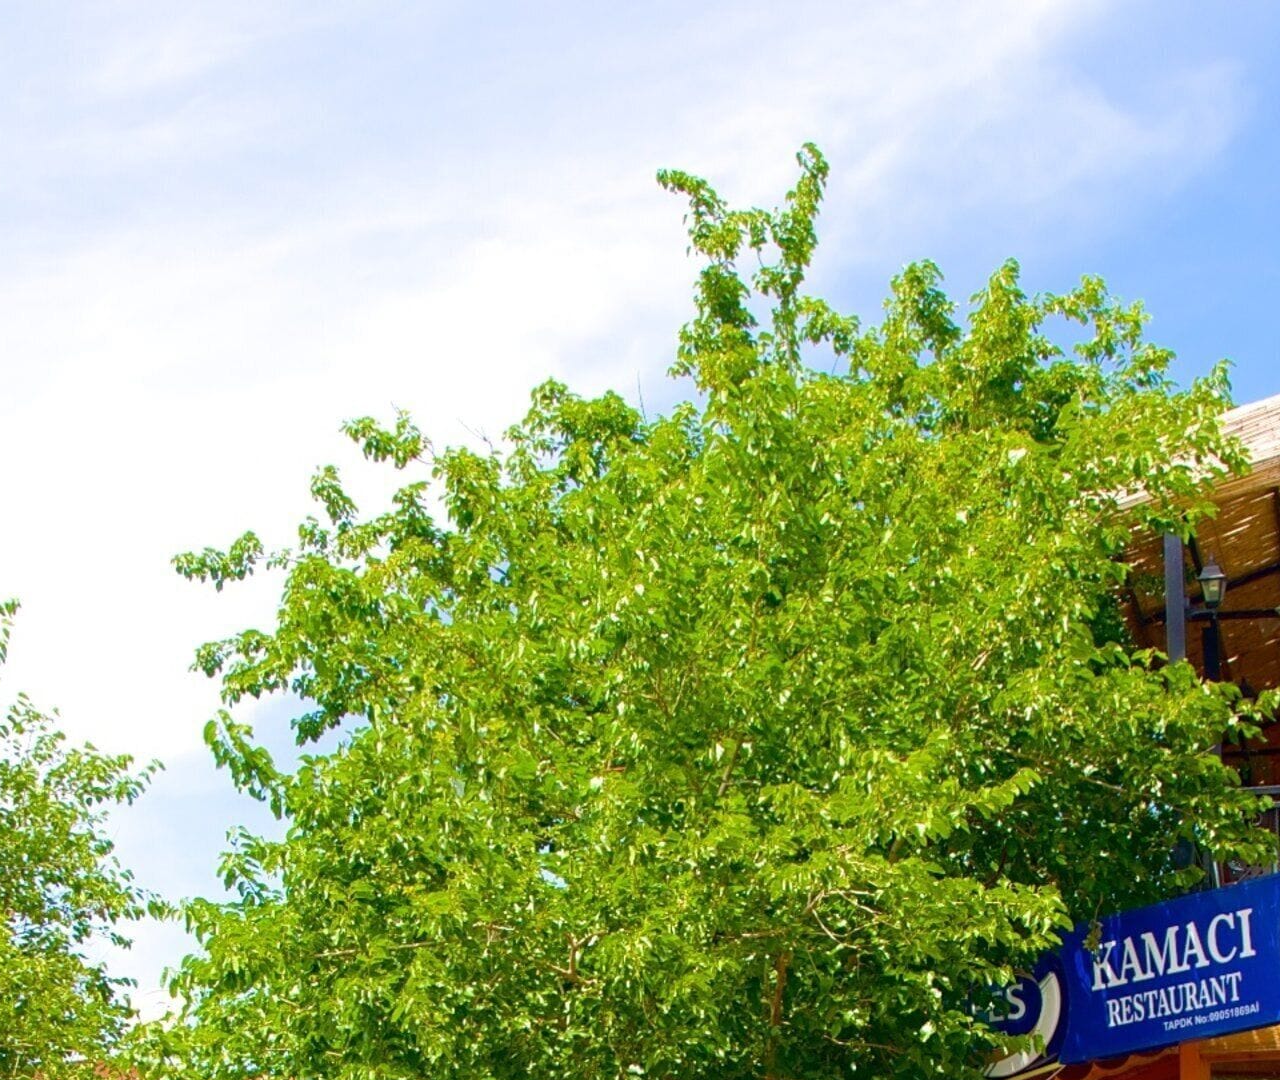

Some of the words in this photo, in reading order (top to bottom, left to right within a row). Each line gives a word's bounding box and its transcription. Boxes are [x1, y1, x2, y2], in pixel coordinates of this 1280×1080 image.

[1091, 907, 1257, 991] KAMACI
[1106, 971, 1243, 1028] RESTAURANT
[1163, 1016, 1193, 1031] TAPDK
